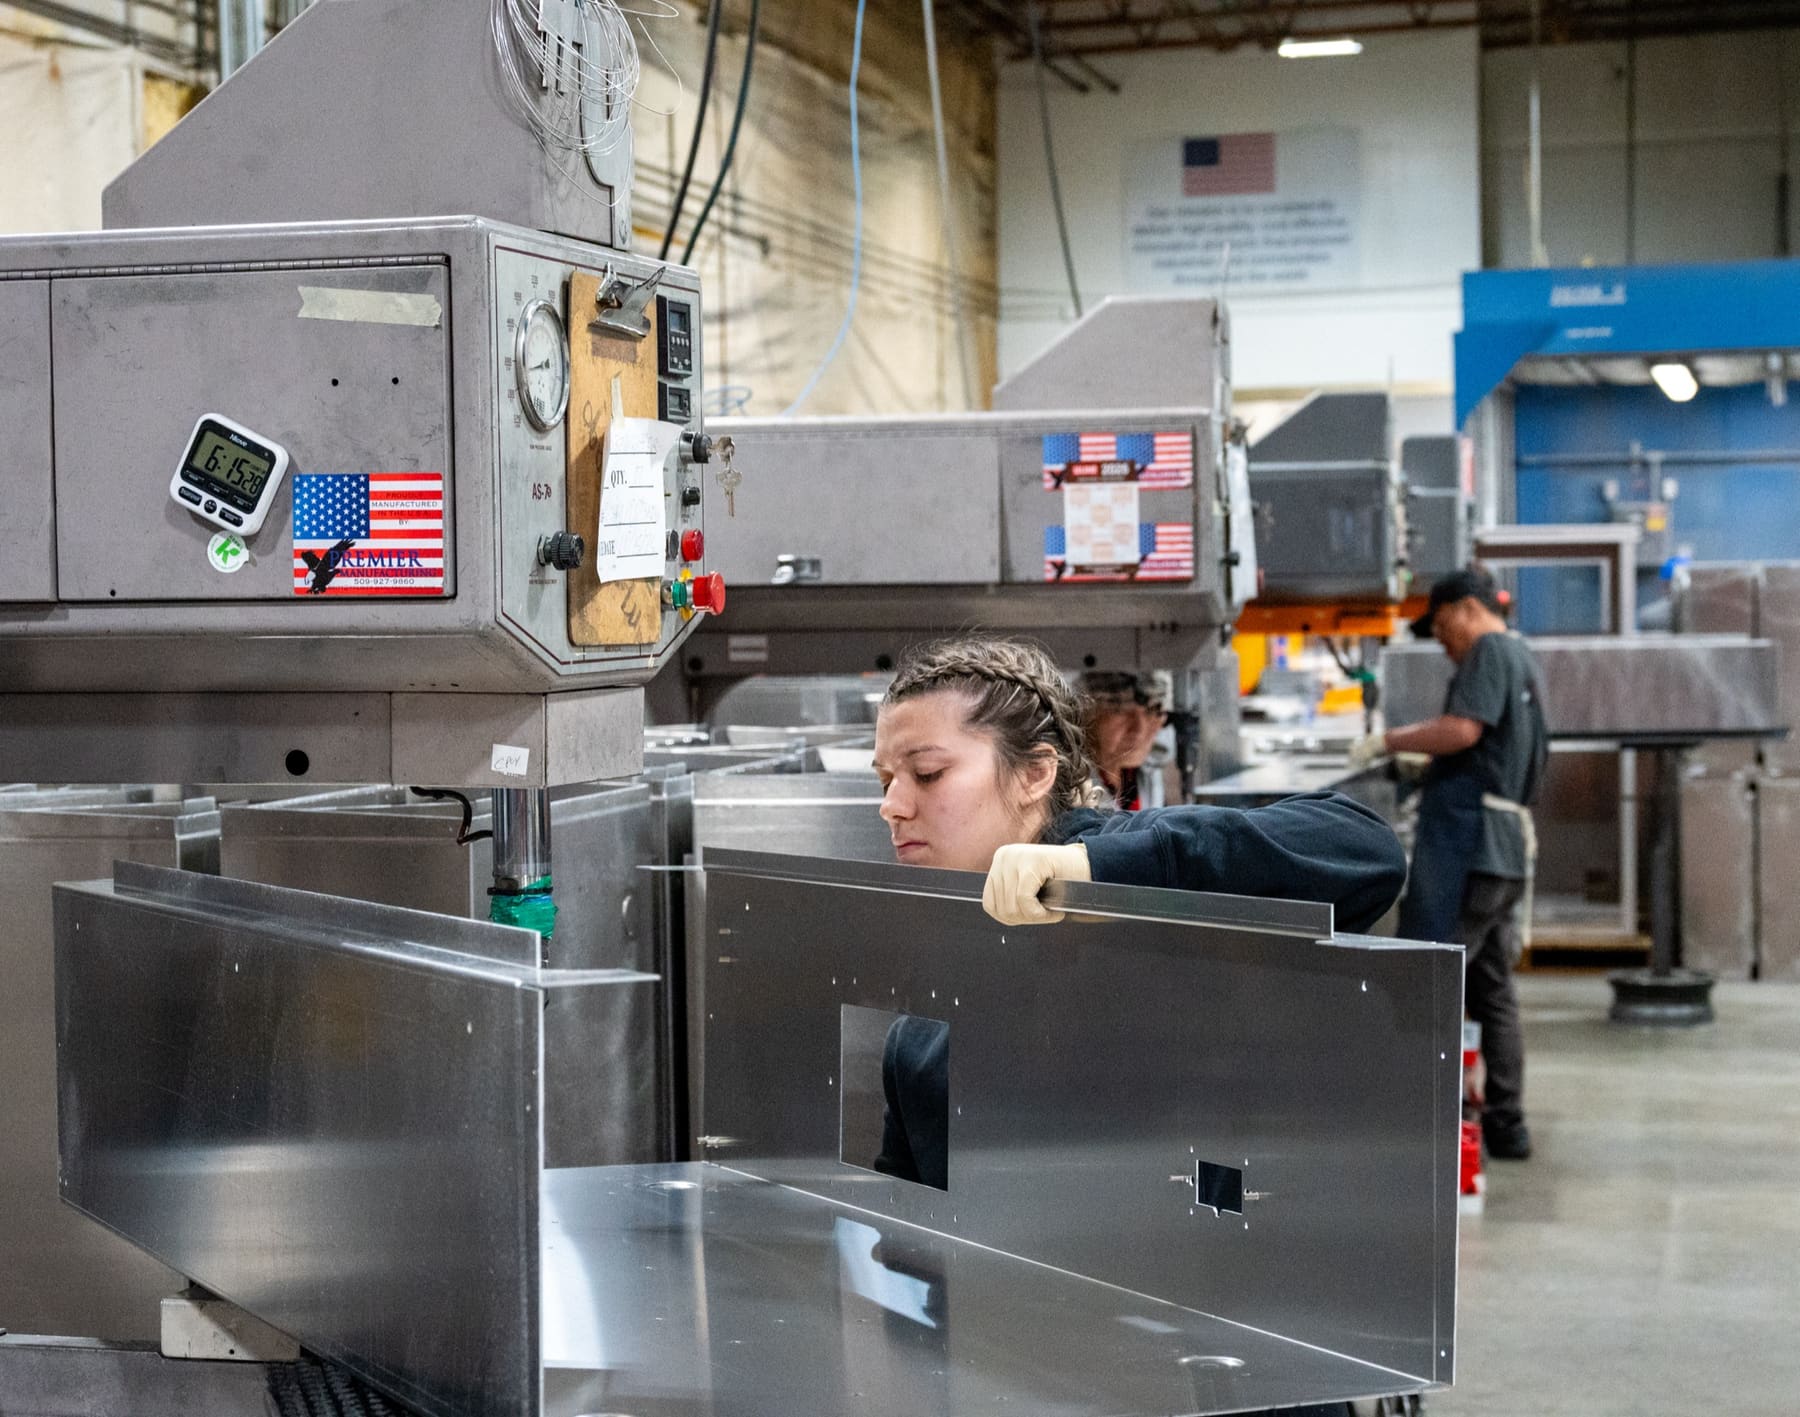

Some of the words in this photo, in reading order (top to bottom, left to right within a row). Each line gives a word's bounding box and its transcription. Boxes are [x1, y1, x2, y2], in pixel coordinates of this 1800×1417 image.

[610, 470, 627, 488] QTY.
[330, 550, 423, 568] PREMIER
[339, 568, 437, 577] MANUFACTURING
